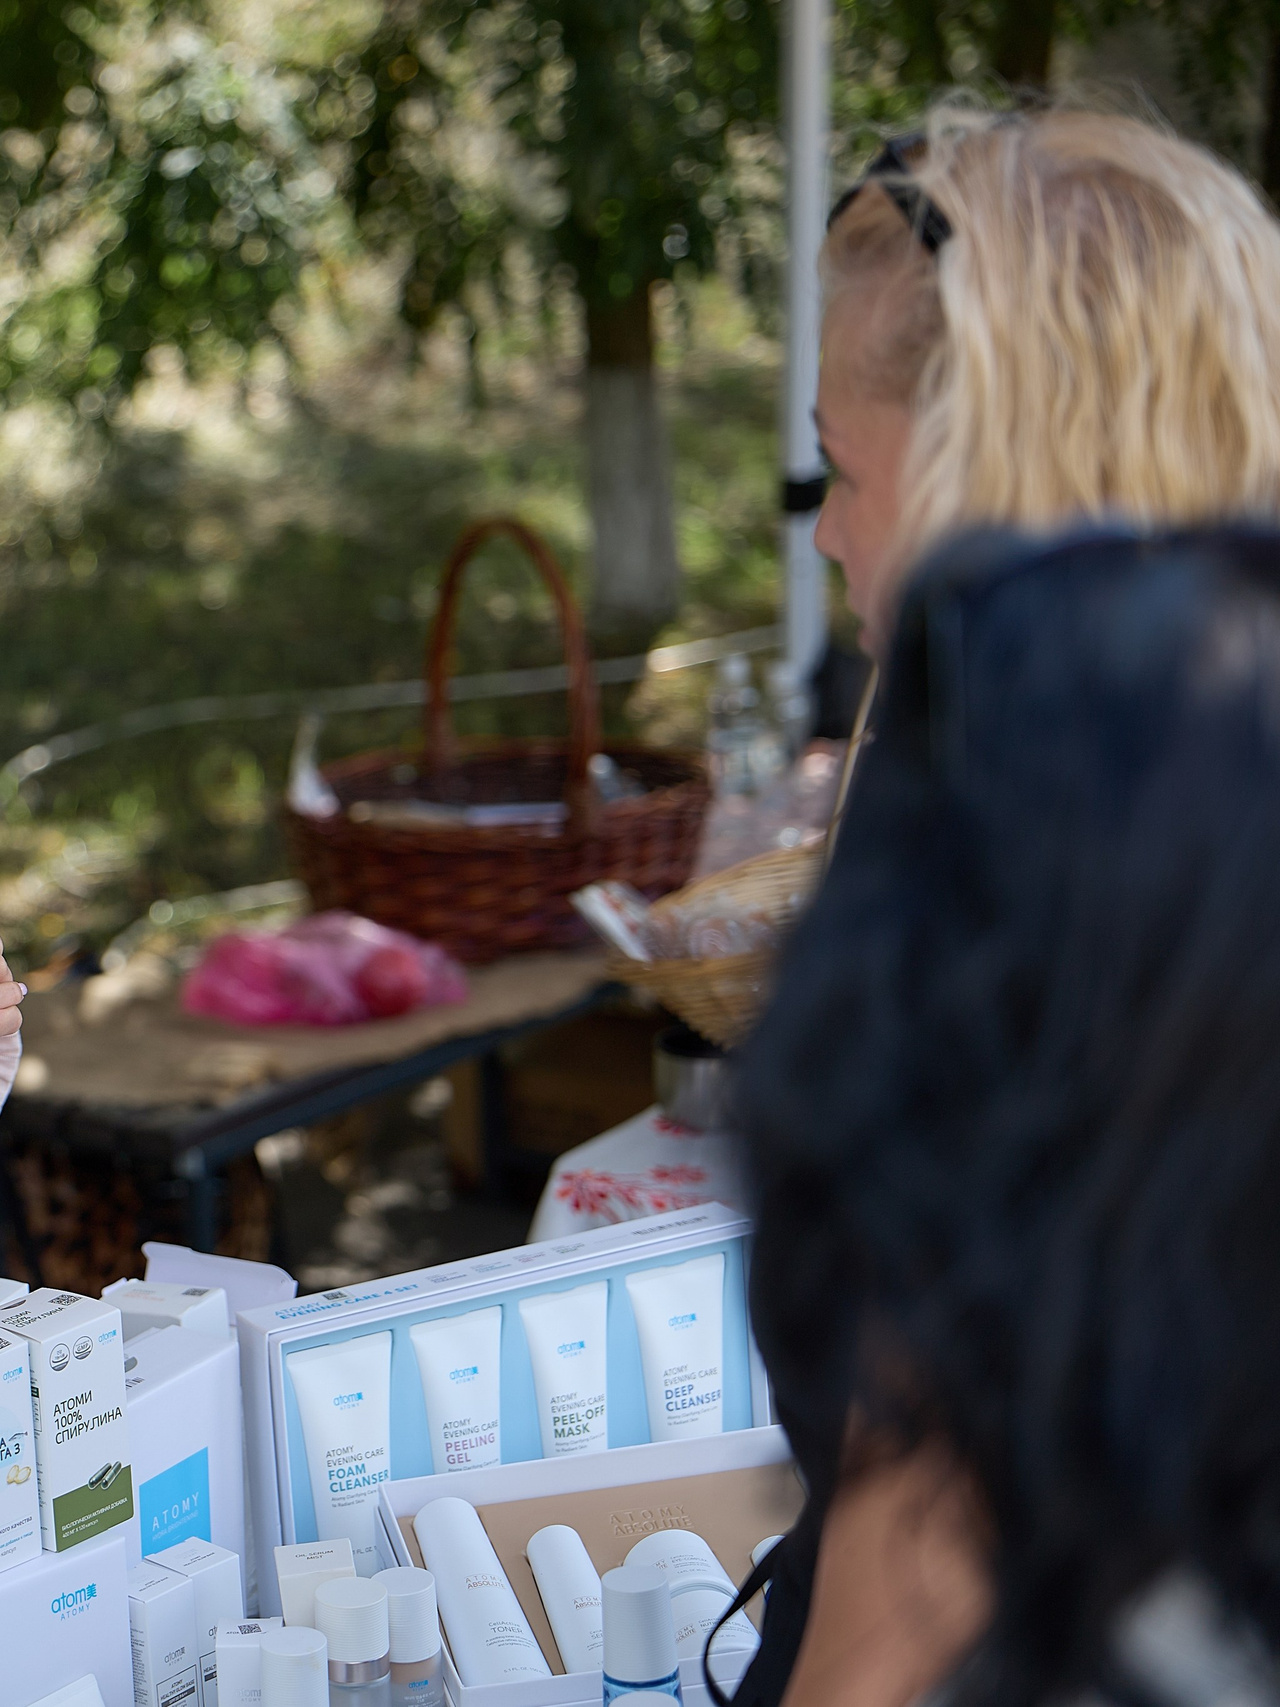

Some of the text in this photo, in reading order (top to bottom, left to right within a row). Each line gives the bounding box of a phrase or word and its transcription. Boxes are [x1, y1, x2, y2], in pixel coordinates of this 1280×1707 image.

[274, 1301, 320, 1316] ATOMY
[279, 1302, 342, 1320] EVENING
[344, 1293, 380, 1305] CARE
[395, 1284, 419, 1293] SET
[663, 1364, 688, 1377] ATOMY
[664, 1367, 718, 1387] EVENING CARE
[550, 1391, 578, 1404] ATOMY
[665, 1384, 694, 1400] DEEP
[53, 1389, 93, 1417] АТОМИ
[551, 1393, 605, 1413] EVENING CARE
[54, 1409, 83, 1430] 100%
[442, 1417, 471, 1430] ATOMY
[552, 1404, 605, 1426] PEEL-OFF
[55, 1406, 122, 1445] СПИРУЛИНА
[444, 1420, 499, 1439] EVENING CARE
[554, 1422, 590, 1439] MASK
[14, 1442, 21, 1455] 3
[445, 1433, 495, 1452] PEELING
[326, 1445, 354, 1458] ATOMY
[327, 1448, 384, 1468] EVENING CARE
[446, 1452, 471, 1465] GEL
[328, 1463, 366, 1480] FOAM
[330, 1469, 389, 1493] CLEANSER
[152, 1492, 199, 1531] ATOMY
[610, 1505, 686, 1524] ATOMY
[11, 1516, 33, 1529] качества
[614, 1516, 692, 1536] ABSOLUTE
[467, 1580, 506, 1590] ABSOLUTE
[573, 1597, 599, 1605] ATOM
[575, 1601, 601, 1610] ABSOLUT
[60, 1603, 91, 1622] ATOMY
[490, 1626, 523, 1635] TONER
[678, 1624, 694, 1636] OMY
[203, 1663, 217, 1673] HEALT
